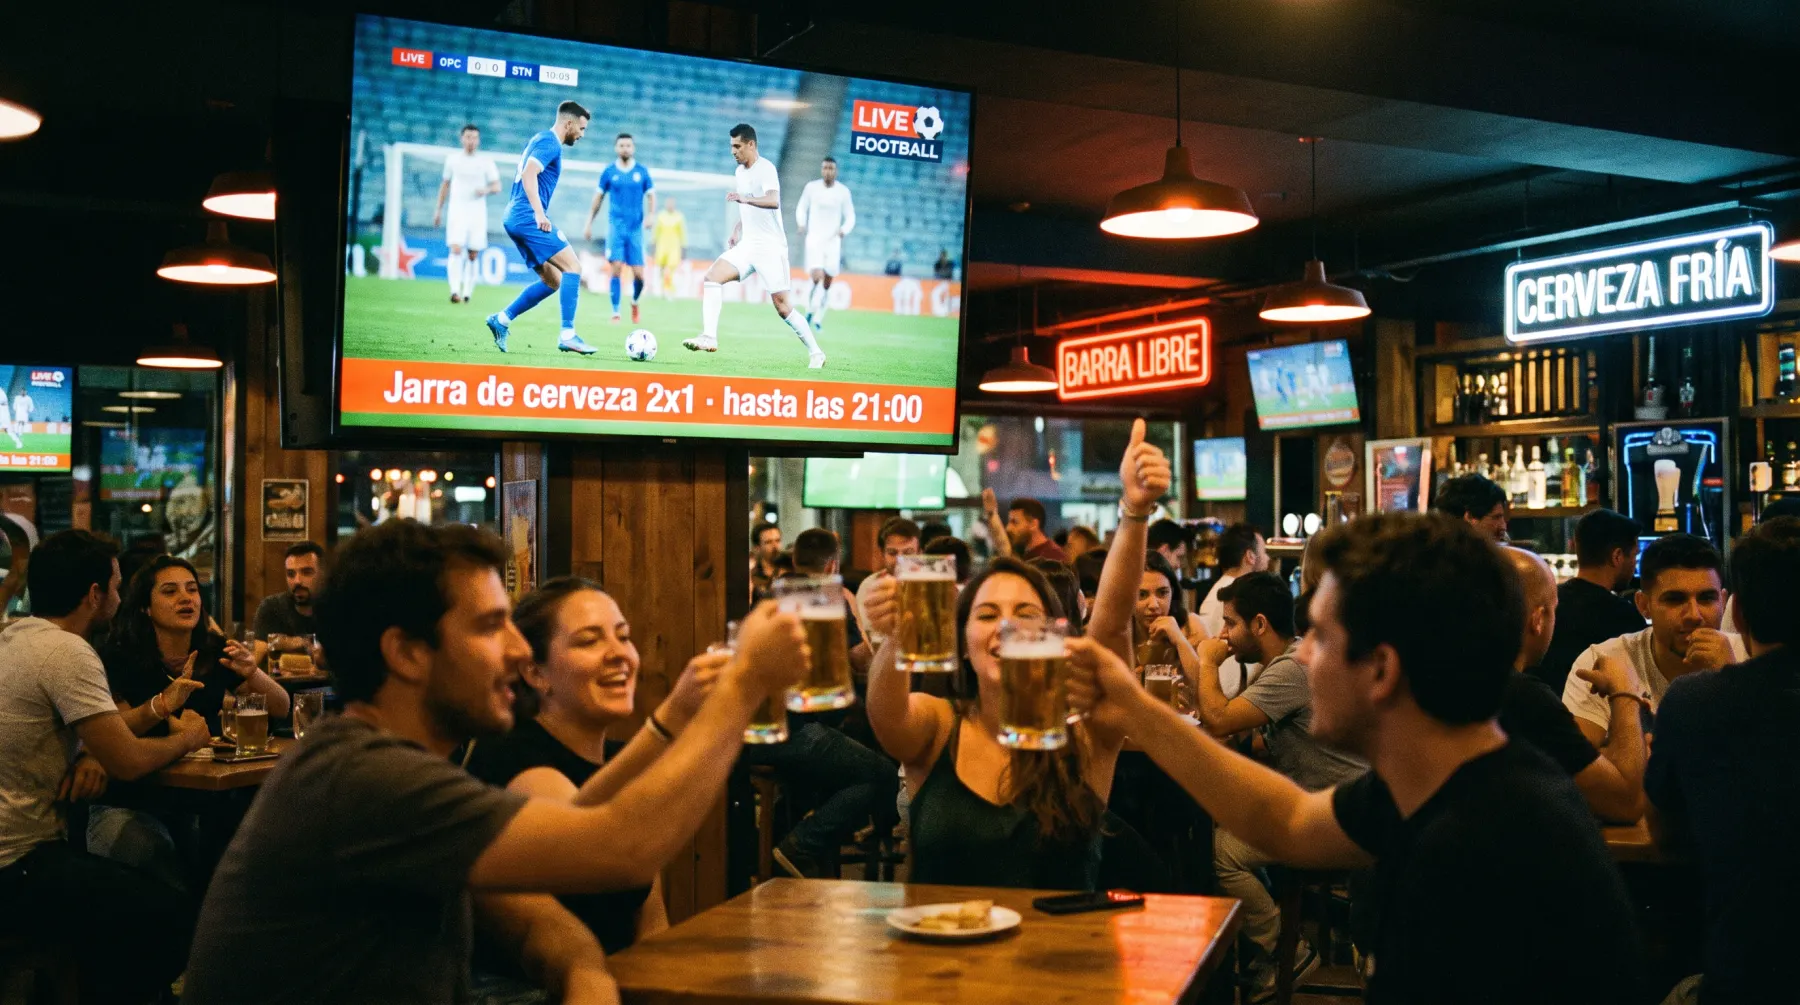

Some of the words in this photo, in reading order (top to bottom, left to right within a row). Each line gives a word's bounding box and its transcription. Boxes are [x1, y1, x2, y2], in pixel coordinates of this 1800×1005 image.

[400, 51, 425, 64] LIVE
[474, 61, 481, 71] 0
[492, 63, 499, 73] 0
[511, 66, 533, 77] STN
[858, 105, 910, 132] LIVE
[855, 135, 939, 159] FOOTBALL
[1516, 260, 1663, 325] CERVEZA
[1669, 238, 1755, 305] FRÍA
[1064, 342, 1133, 388] BARRA
[1136, 332, 1200, 379] LIBRE
[383, 370, 468, 406] Jarra
[477, 374, 515, 407] de
[523, 383, 638, 412] cerveza
[645, 382, 695, 414] 2x1
[723, 385, 798, 418] hasta
[806, 389, 845, 420] las
[851, 392, 923, 424] 21:00
